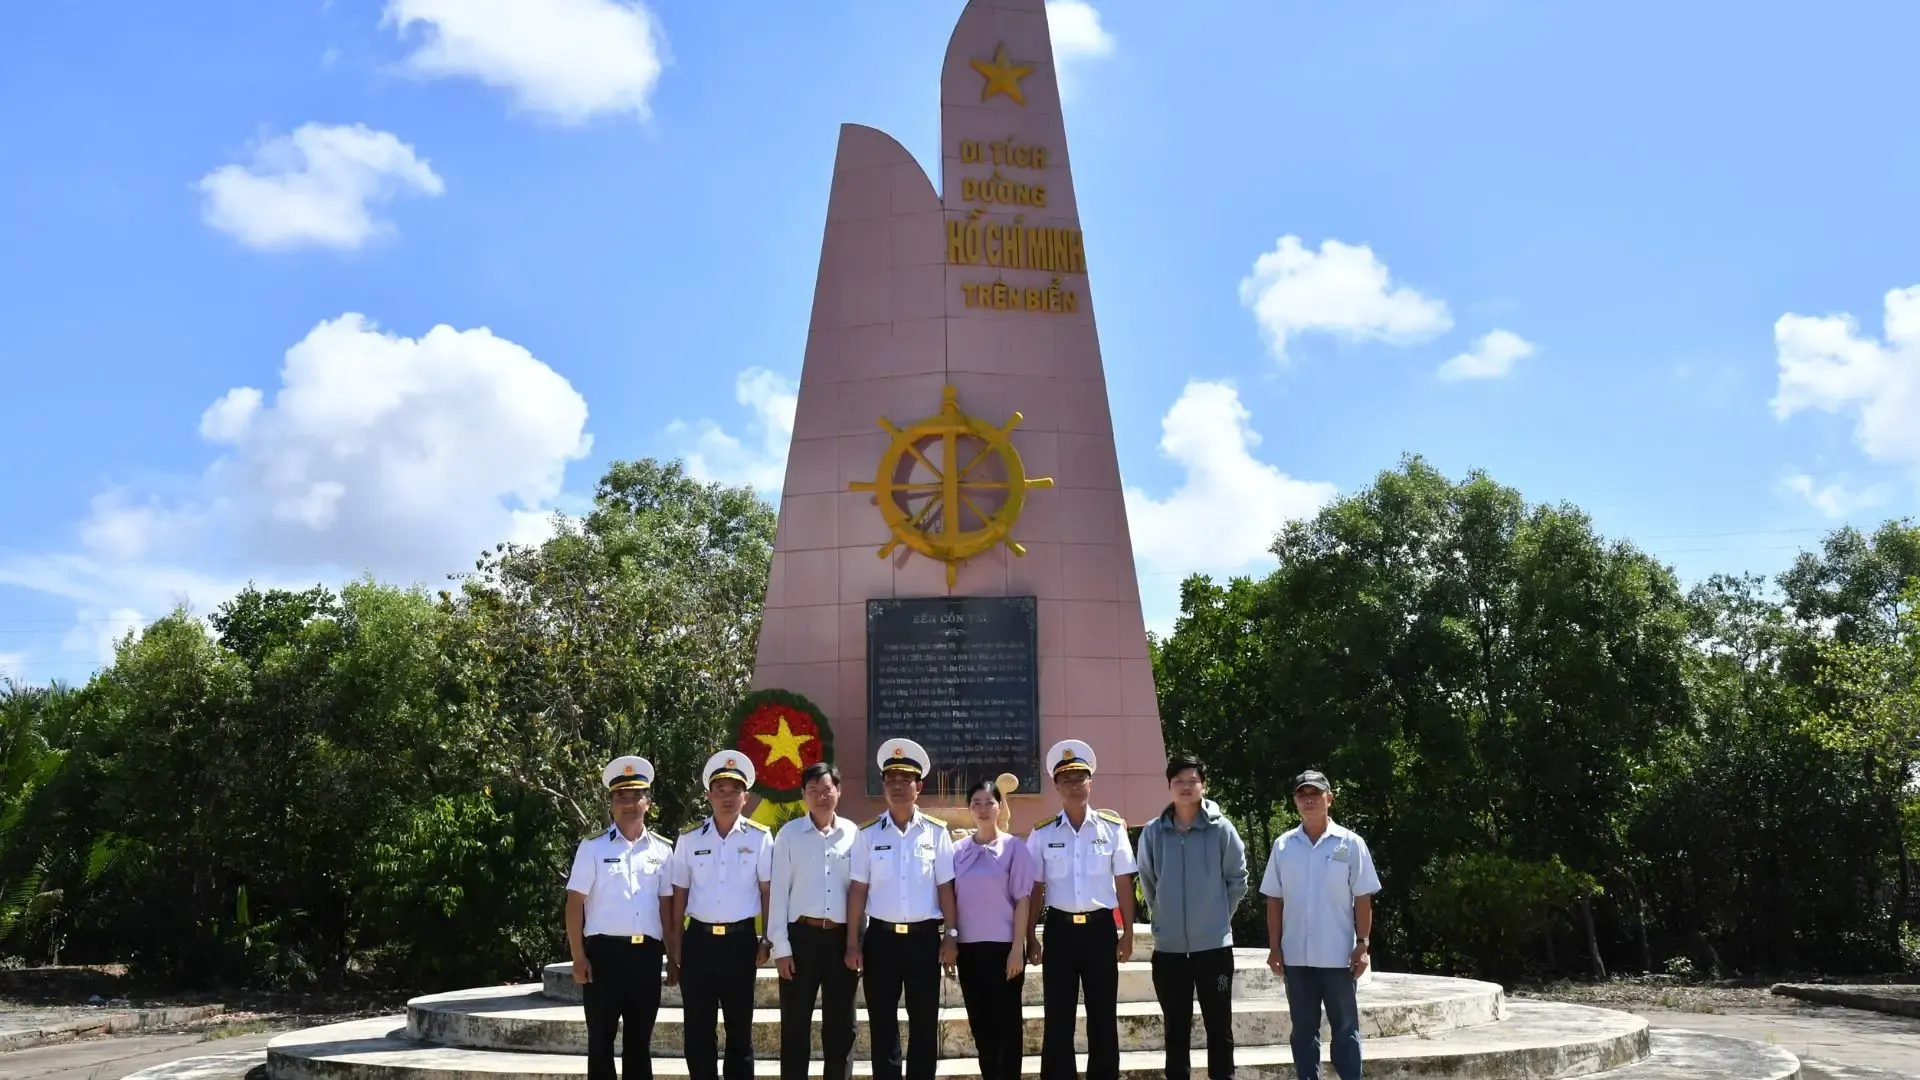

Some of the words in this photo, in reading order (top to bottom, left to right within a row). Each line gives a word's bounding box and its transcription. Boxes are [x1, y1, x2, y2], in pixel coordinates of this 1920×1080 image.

[961, 141, 984, 164] DI
[989, 135, 1047, 169] TÍCH
[947, 208, 985, 264] HỒ
[985, 215, 1025, 268] CHÍ
[1027, 227, 1086, 274] MINH
[961, 278, 1021, 310] TRÊN
[1025, 277, 1077, 313] BIỂN
